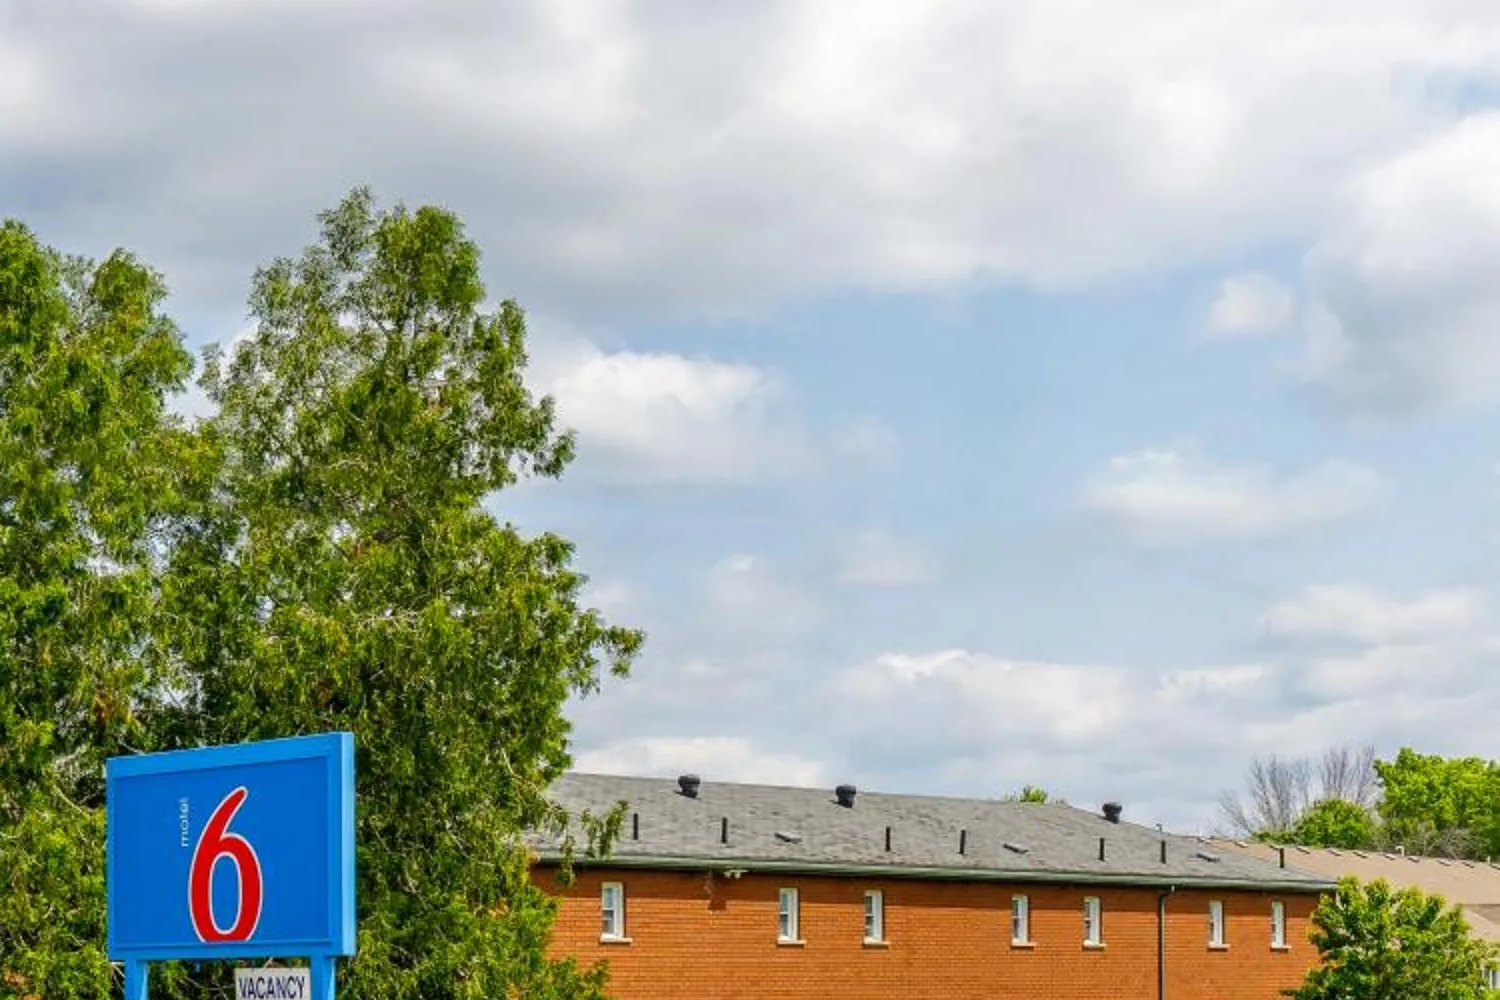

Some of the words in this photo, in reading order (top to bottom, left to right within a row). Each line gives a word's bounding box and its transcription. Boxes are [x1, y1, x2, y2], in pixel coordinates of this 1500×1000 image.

[179, 798, 189, 847] motel
[188, 786, 263, 943] 6
[238, 975, 305, 999] VACANCY
